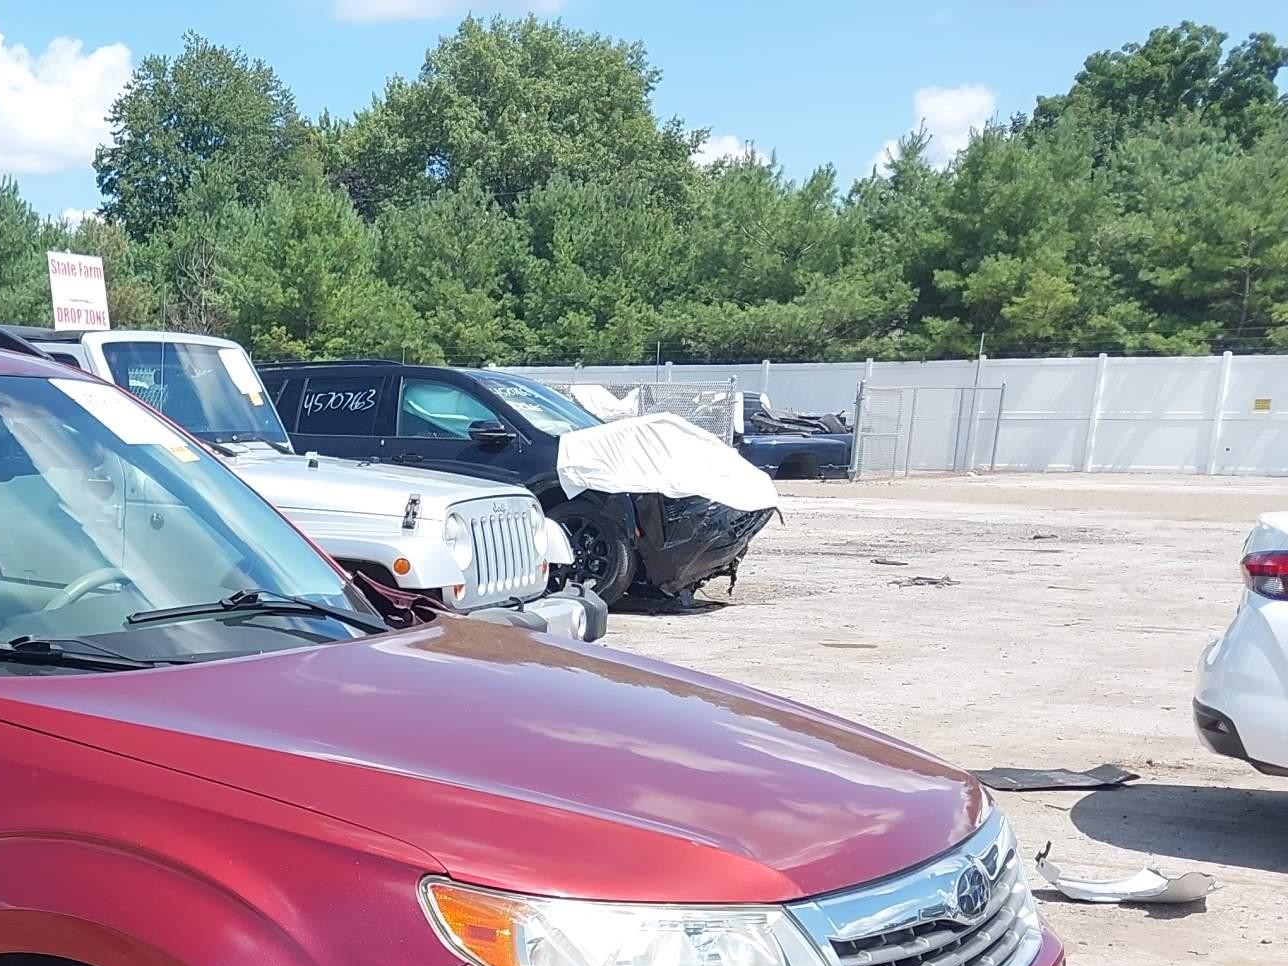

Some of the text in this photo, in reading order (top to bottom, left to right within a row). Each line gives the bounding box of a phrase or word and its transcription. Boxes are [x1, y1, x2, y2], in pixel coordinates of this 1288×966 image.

[50, 259, 103, 280] State Farm
[56, 307, 107, 326] DROP ZONE
